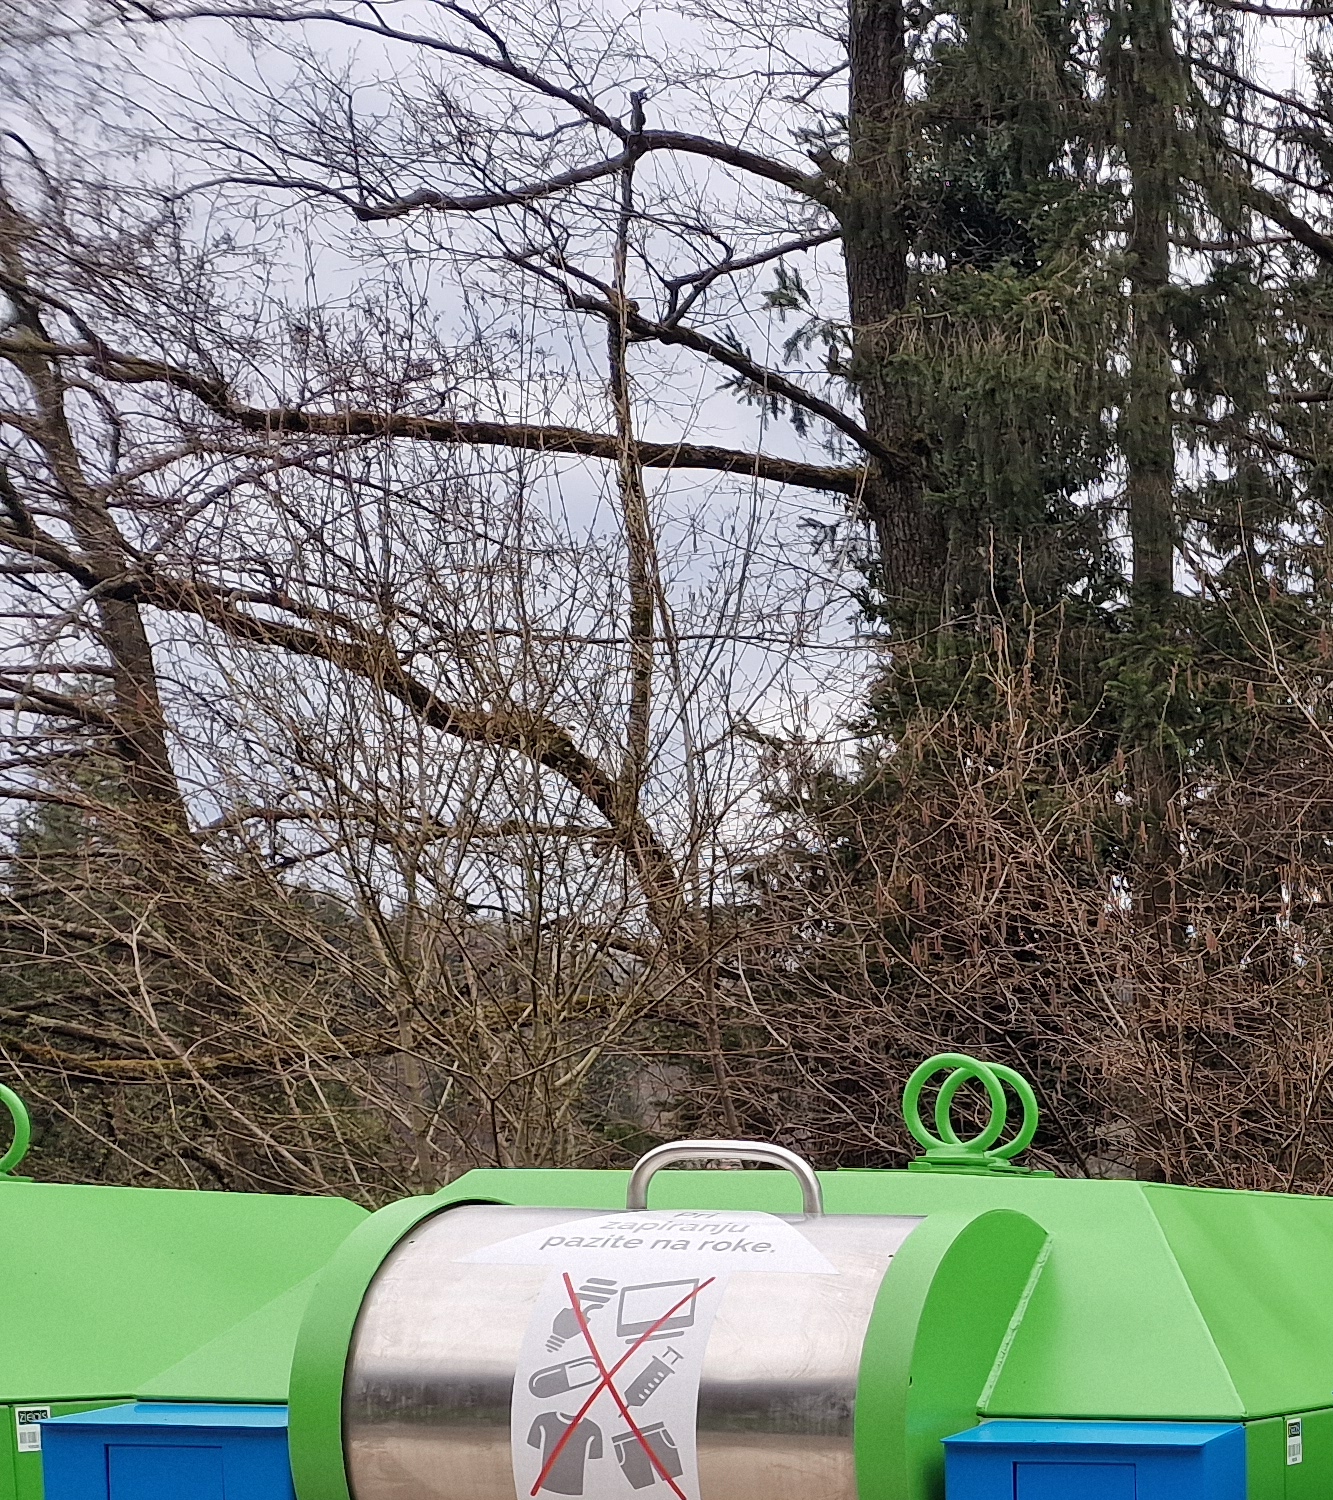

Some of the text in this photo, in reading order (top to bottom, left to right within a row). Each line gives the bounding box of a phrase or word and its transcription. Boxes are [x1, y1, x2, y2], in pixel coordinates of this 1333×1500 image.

[599, 1220, 751, 1235] zapiranju
[539, 1234, 776, 1253] pazite na roke.
